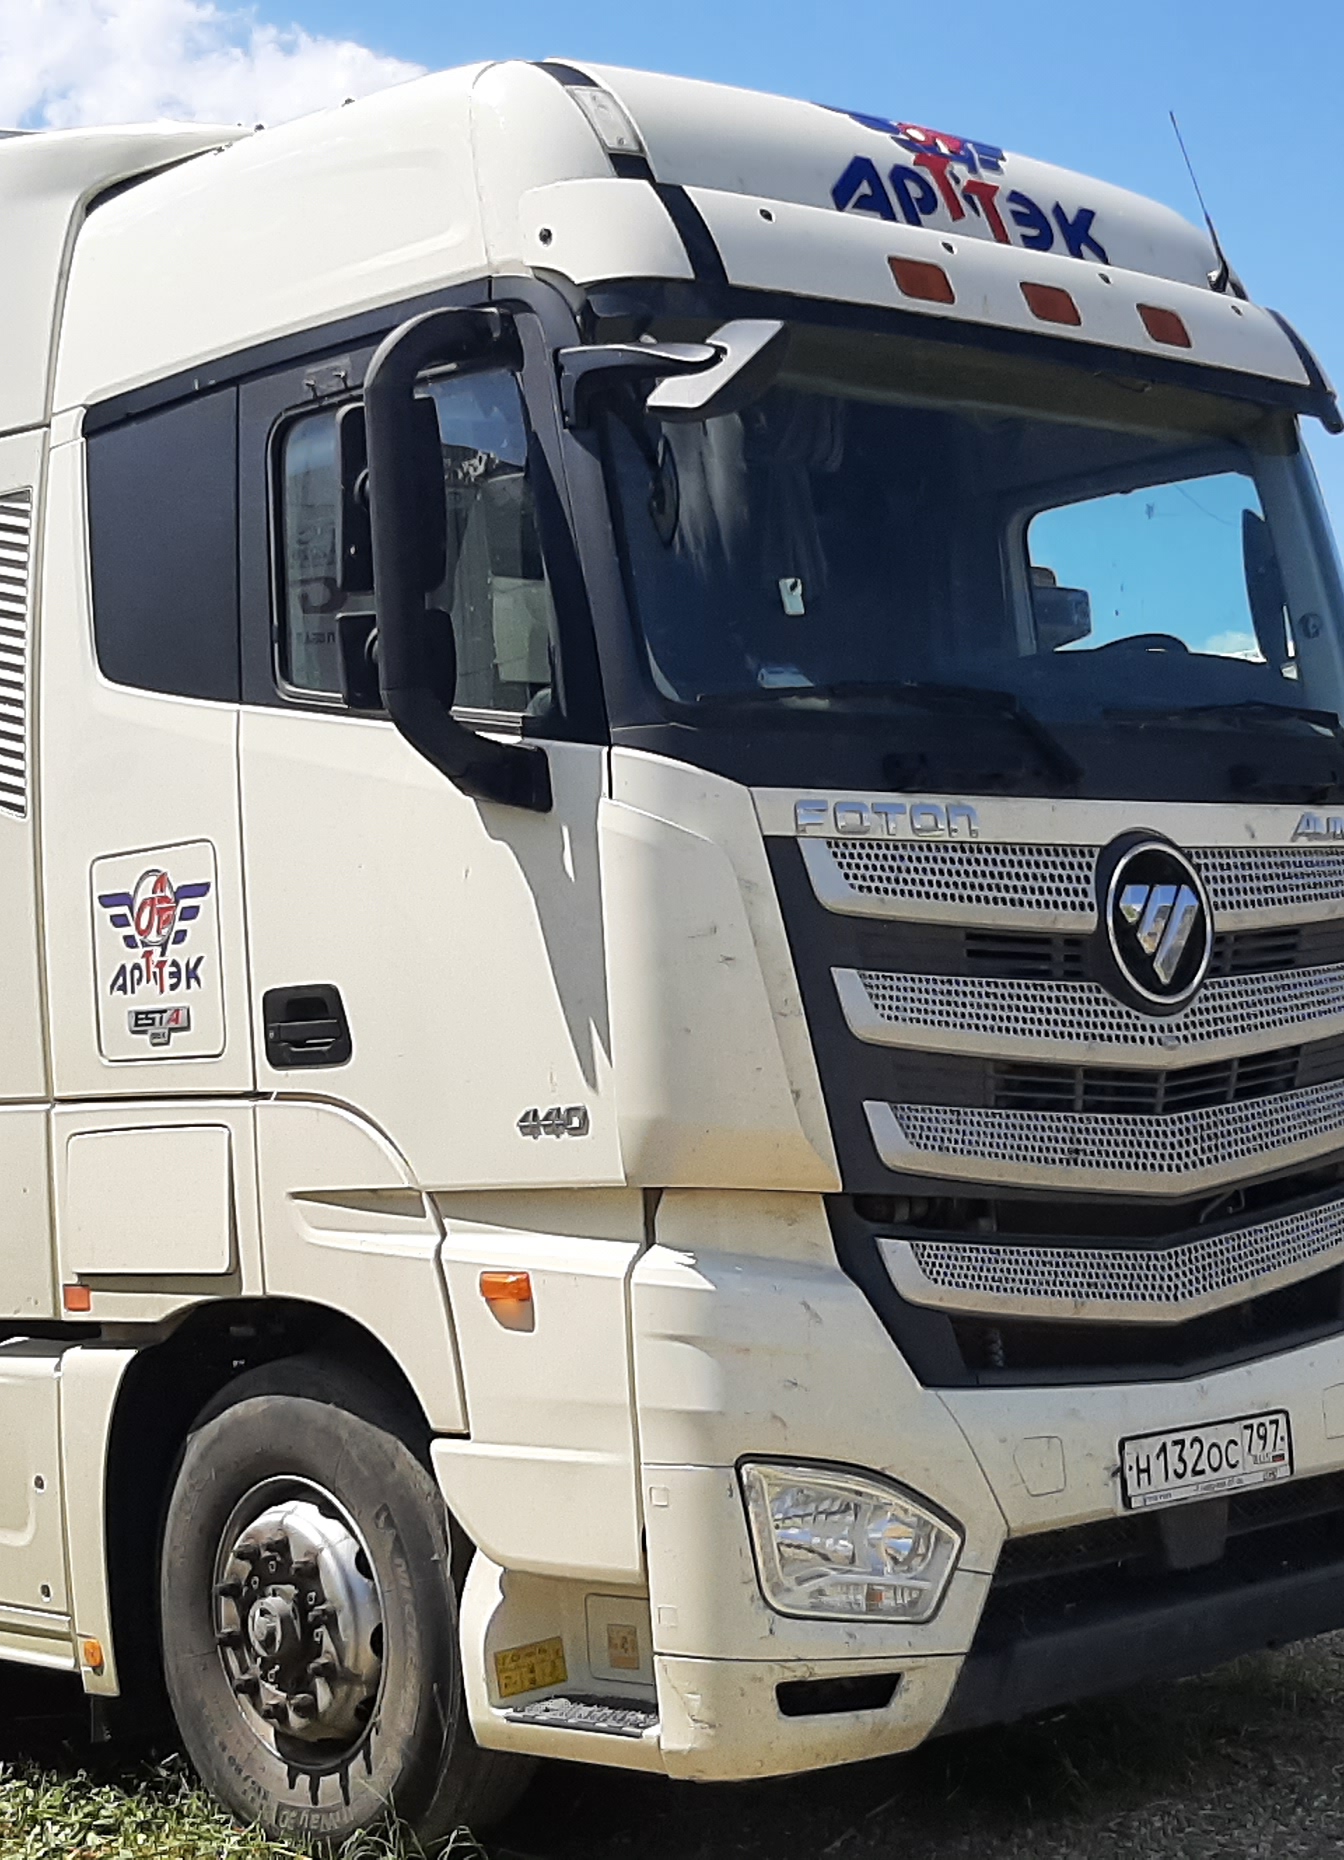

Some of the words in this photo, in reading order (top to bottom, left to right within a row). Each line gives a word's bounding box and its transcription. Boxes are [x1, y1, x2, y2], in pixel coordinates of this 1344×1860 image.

[133, 1008, 183, 1028] ESTA
[516, 1105, 590, 1140] 440
[1243, 1418, 1280, 1453] 797
